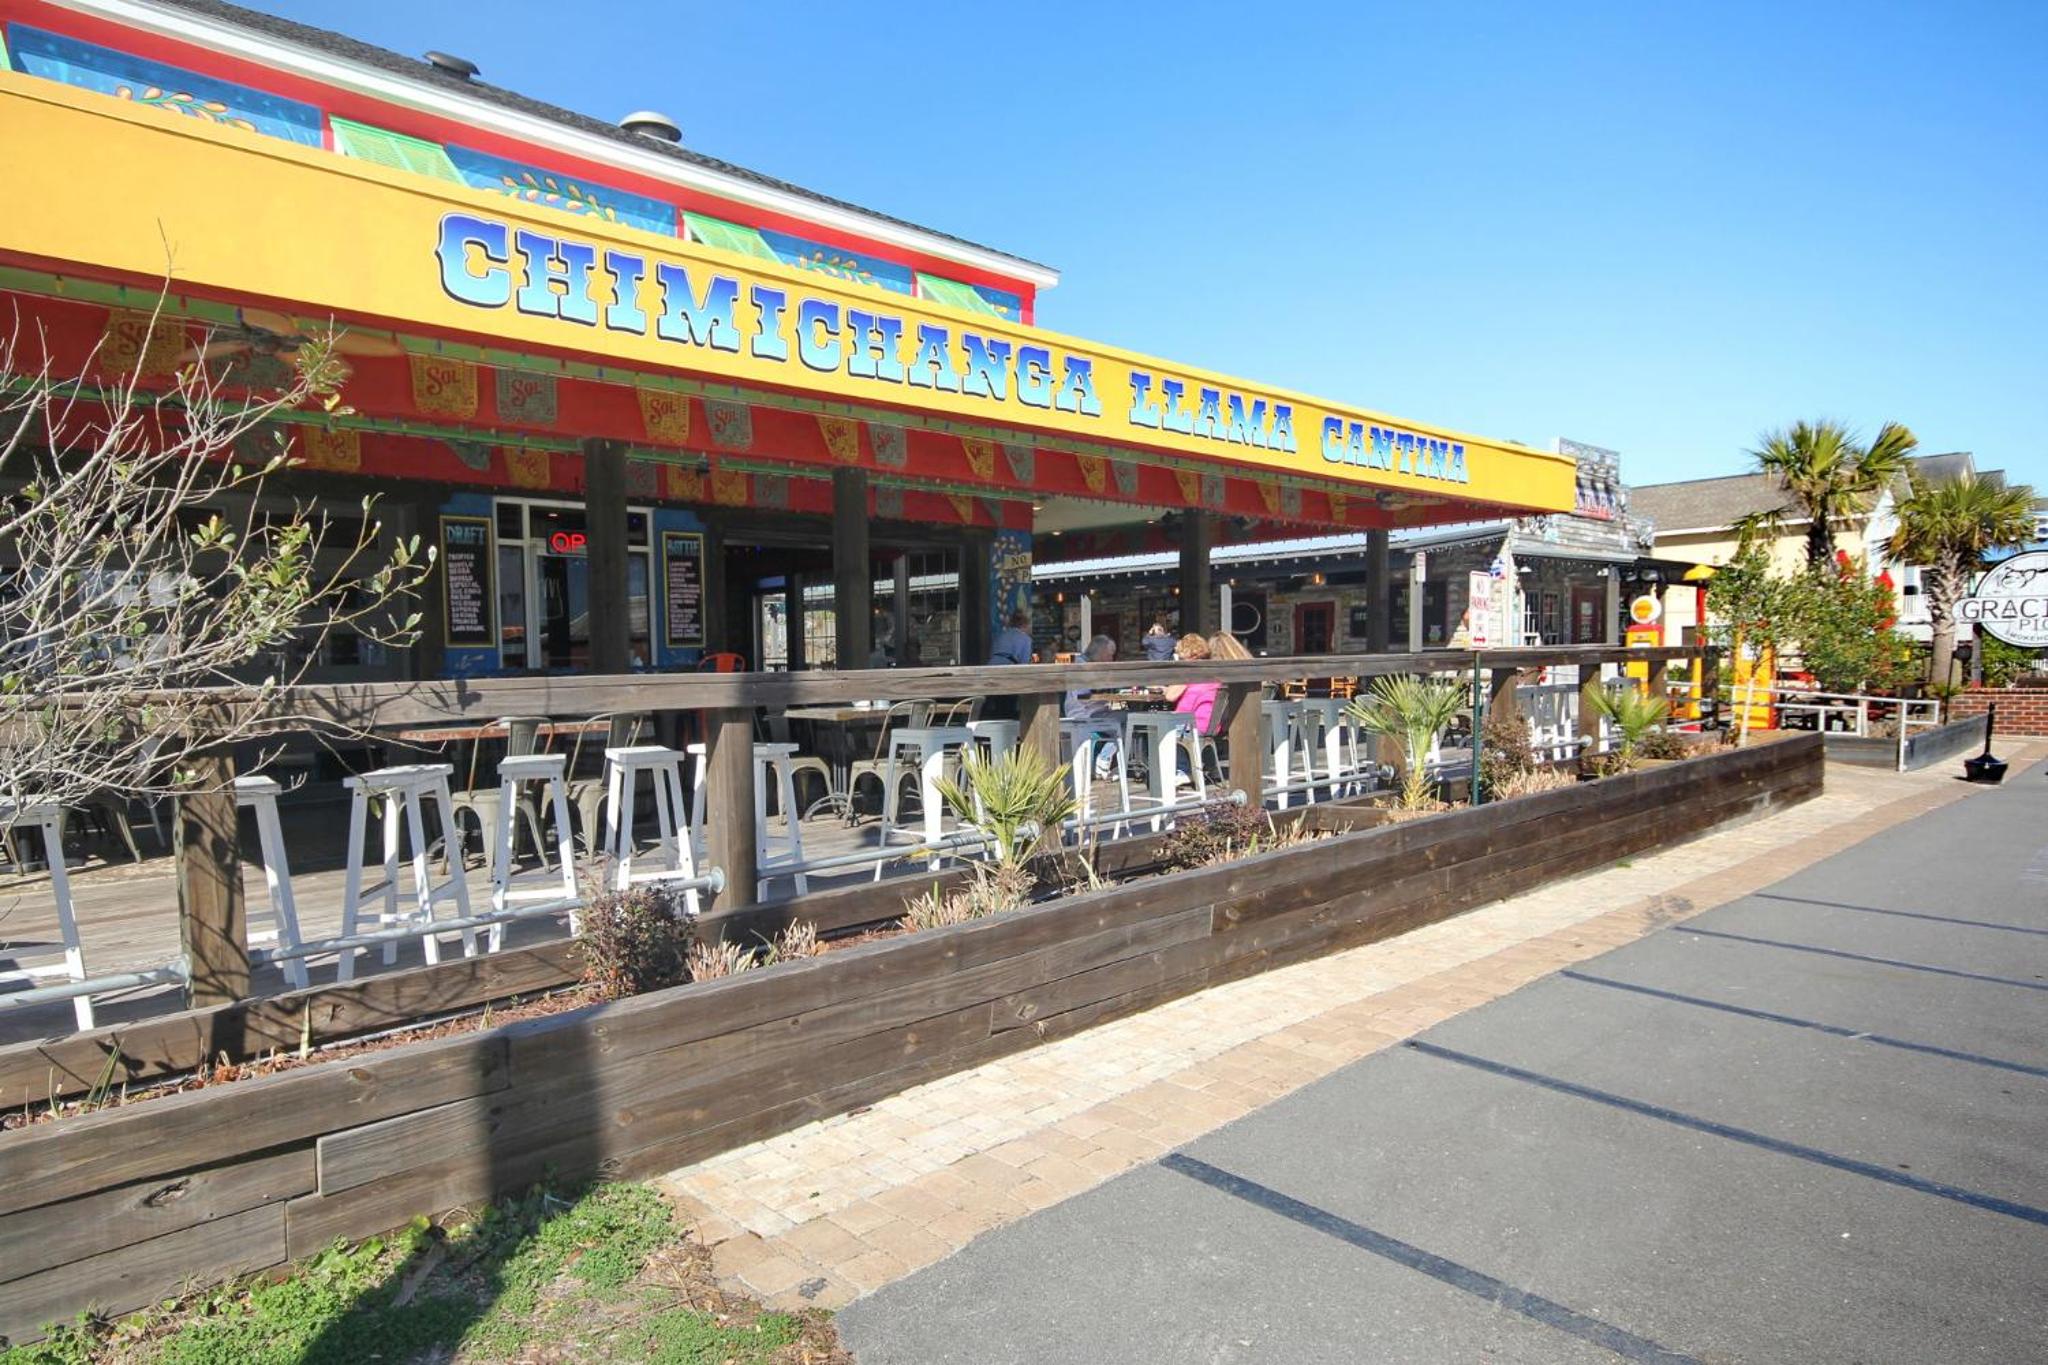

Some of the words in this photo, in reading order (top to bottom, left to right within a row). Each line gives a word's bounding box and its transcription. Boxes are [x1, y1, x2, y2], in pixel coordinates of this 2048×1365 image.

[435, 213, 1101, 417] CHIMICHANGA
[1129, 370, 1297, 453] LLAMA
[1321, 416, 1468, 484] CANTINA
[550, 532, 588, 553] OP
